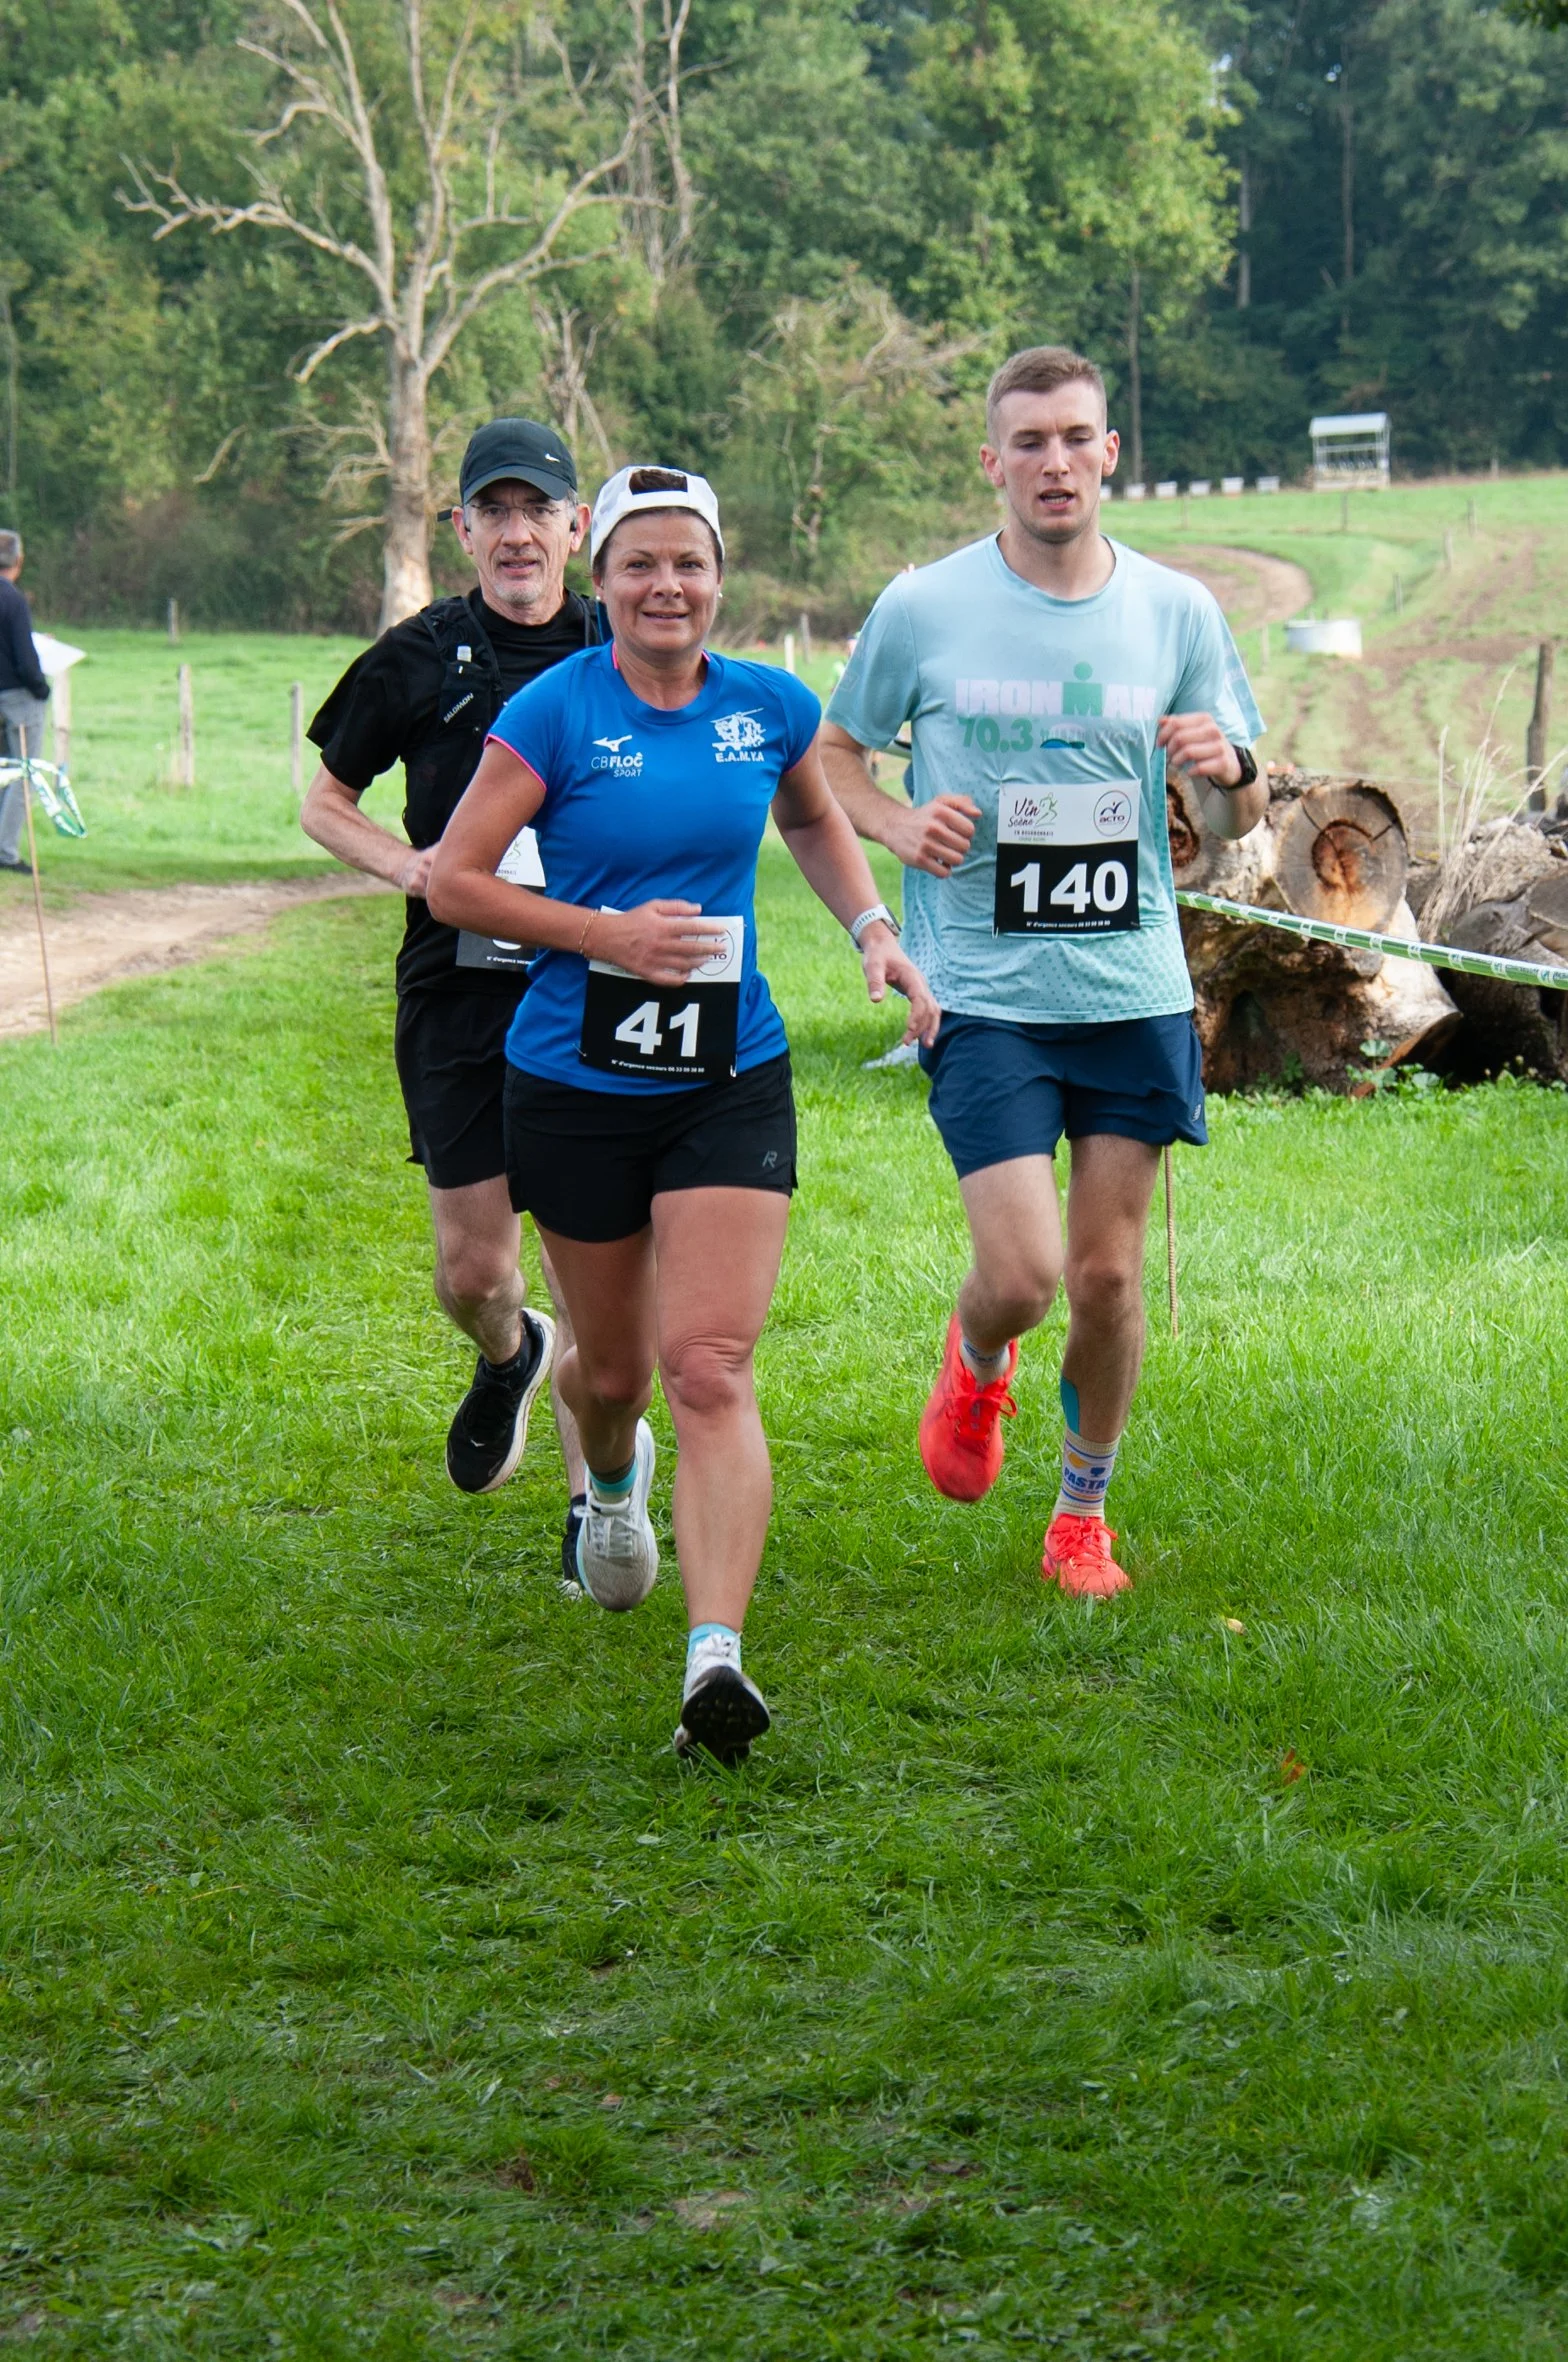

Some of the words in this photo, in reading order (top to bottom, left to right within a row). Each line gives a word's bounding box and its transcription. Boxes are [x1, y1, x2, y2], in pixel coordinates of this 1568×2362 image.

[443, 692, 474, 723] SALOMON
[955, 679, 1157, 720] IRONMAN
[958, 716, 1034, 753] 70.3
[613, 769, 643, 778] SPORT
[1014, 797, 1041, 817] Vin
[1010, 861, 1129, 914] 140
[615, 1001, 700, 1058] 41
[762, 1150, 778, 1168] R
